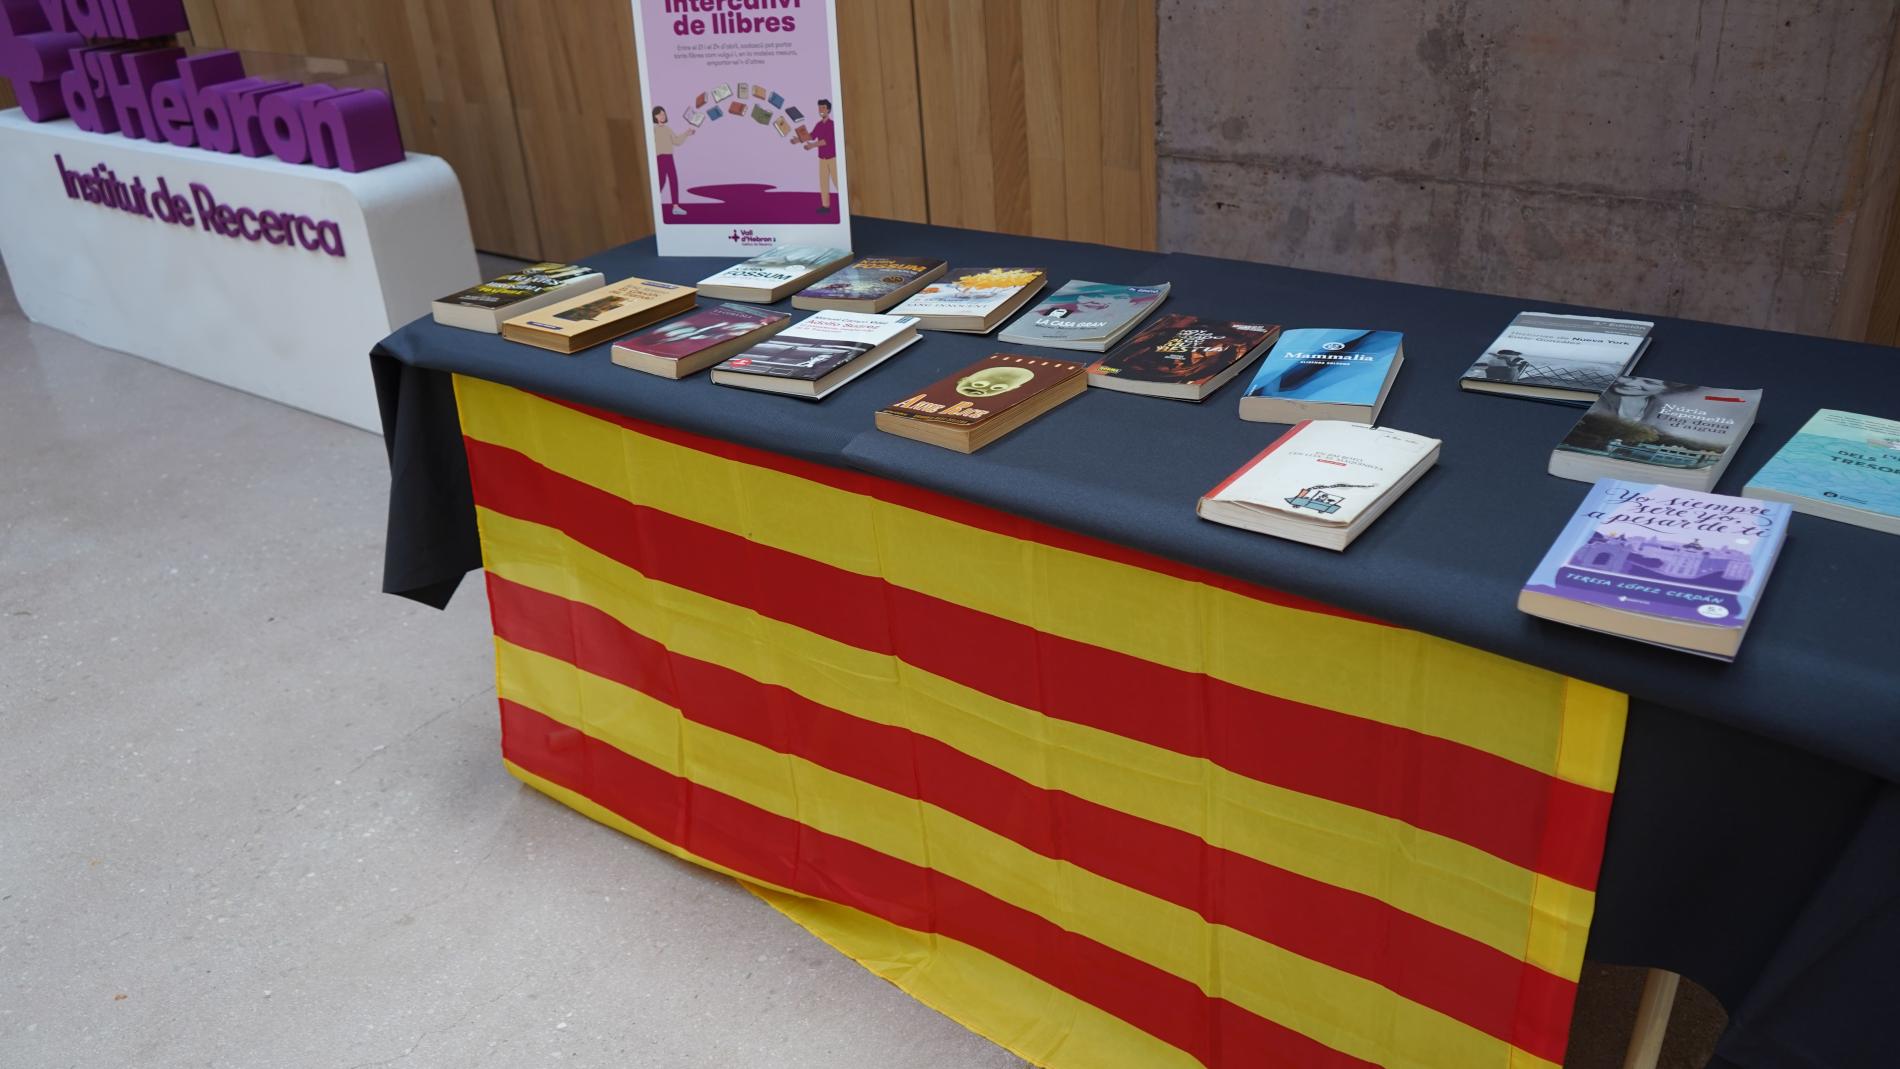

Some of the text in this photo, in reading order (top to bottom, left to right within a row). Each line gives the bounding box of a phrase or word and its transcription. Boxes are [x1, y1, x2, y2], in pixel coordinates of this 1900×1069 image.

[673, 11, 796, 36] de llibres
[60, 50, 356, 172] d'Hebron
[54, 153, 346, 257] Institut de Recerca
[723, 270, 792, 281] FOSSUM
[1035, 318, 1050, 326] LA
[1050, 320, 1075, 328] CASA
[1572, 336, 1604, 344] Nueva
[1284, 352, 1375, 362] Mammalia
[1659, 408, 1735, 425] Esponellà
[1662, 403, 1708, 416] Núria
[1657, 413, 1730, 430] Una dona
[1669, 422, 1728, 435] d'aigua
[1838, 450, 1878, 461] DELS
[1605, 487, 1771, 517] Yo siempre
[1635, 502, 1689, 518] seré
[1584, 510, 1771, 538] a pesar de ti
[1566, 572, 1612, 586] TERESA
[1617, 582, 1662, 595] LÓPEZ
[1666, 590, 1725, 604] CERDÁN
